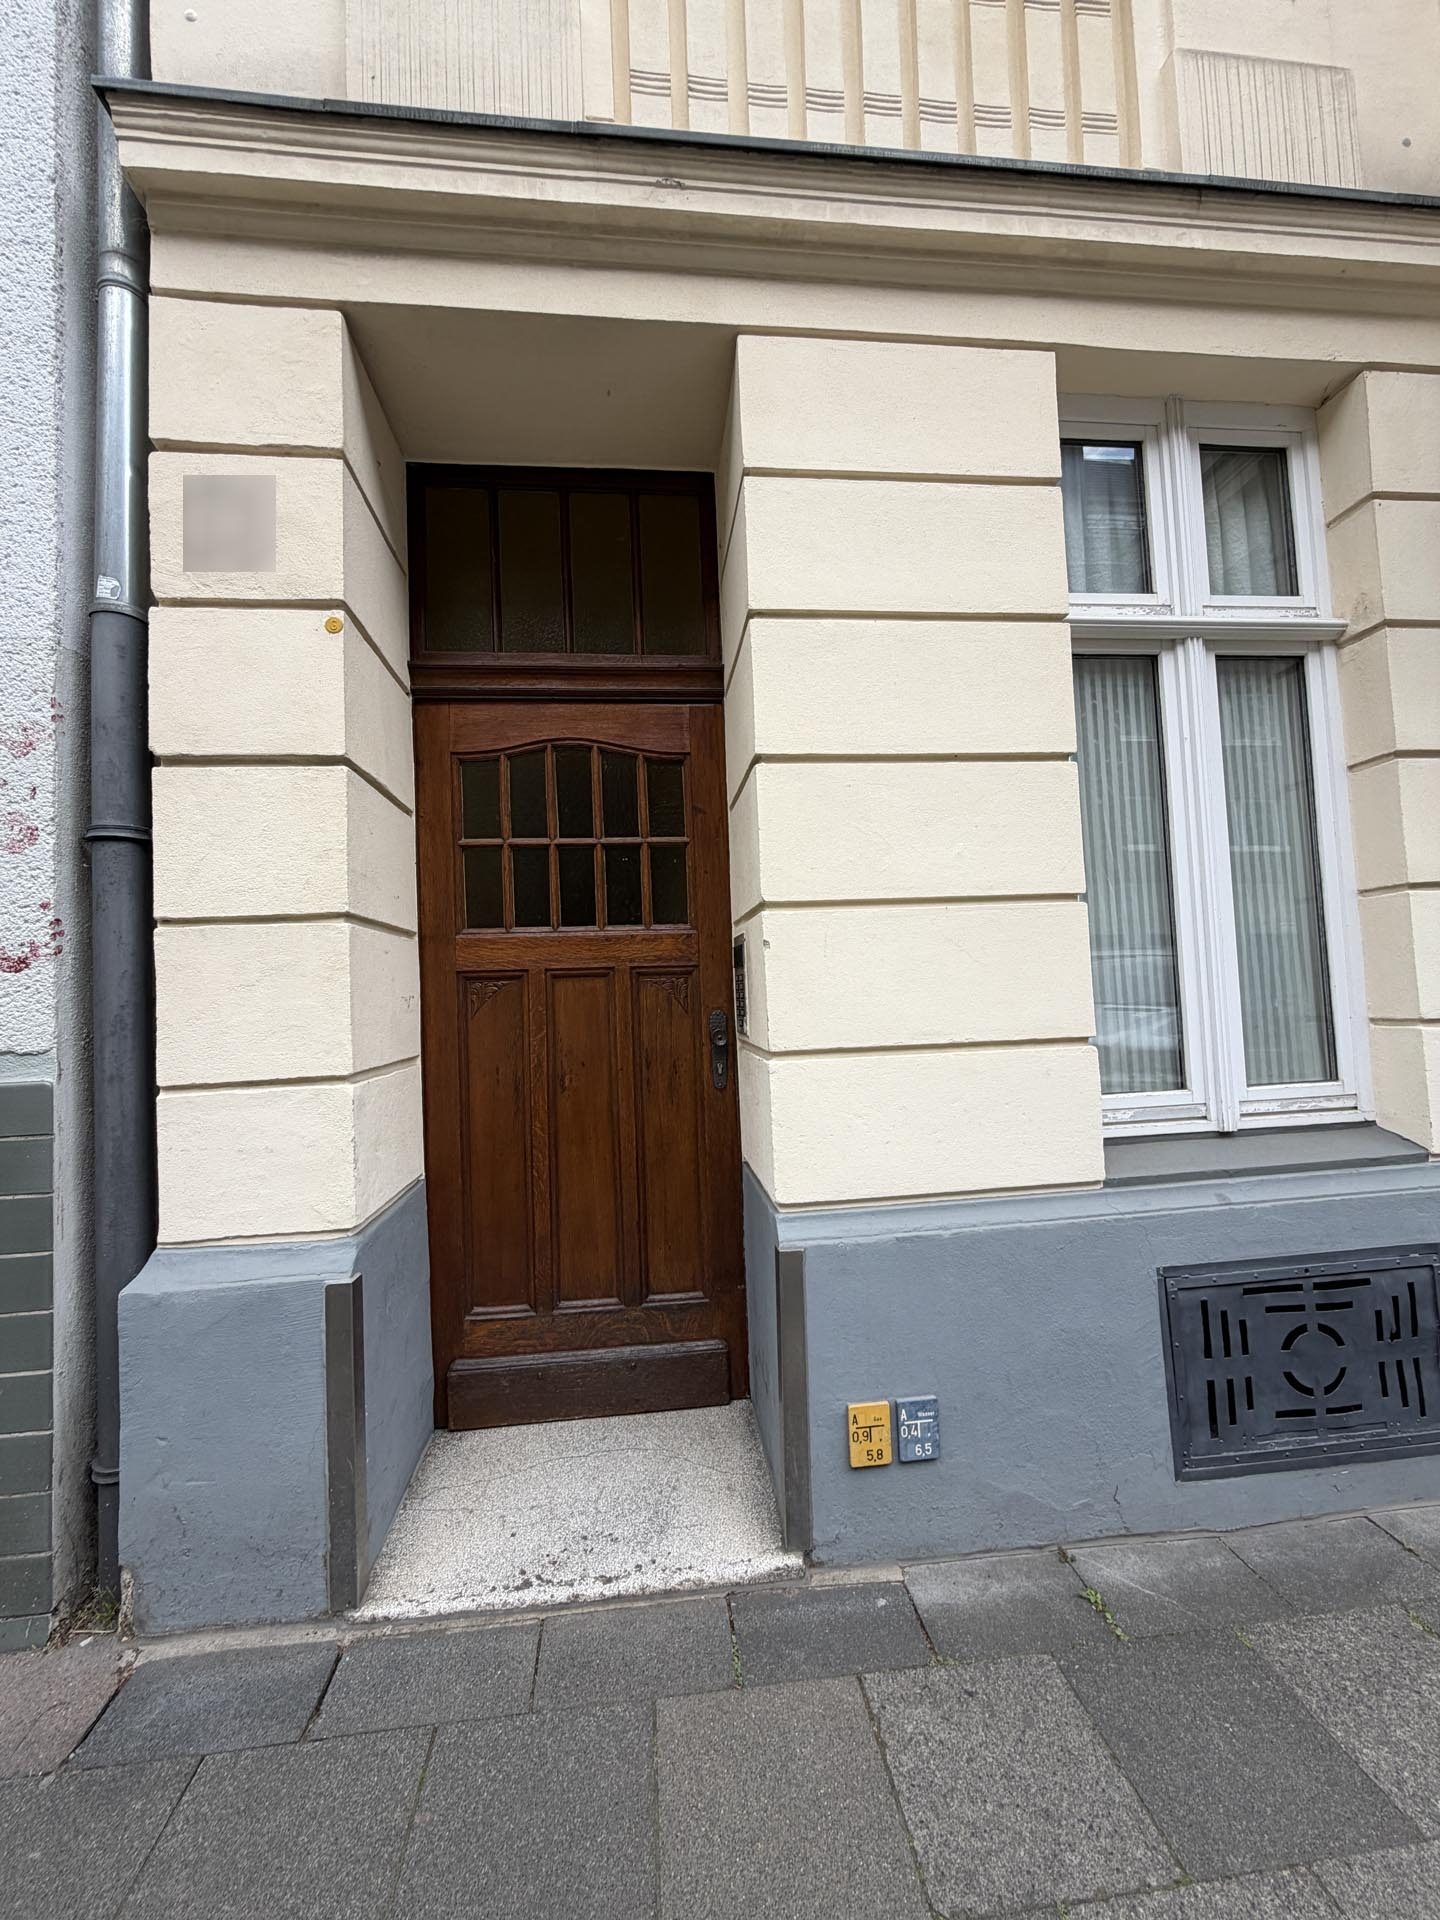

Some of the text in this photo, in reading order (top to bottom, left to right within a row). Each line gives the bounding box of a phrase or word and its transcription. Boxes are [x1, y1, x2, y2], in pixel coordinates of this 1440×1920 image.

[852, 1413, 858, 1425] A
[900, 1408, 907, 1421] A
[852, 1430, 869, 1444] 0,9
[900, 1425, 918, 1439] 0,4
[866, 1449, 883, 1462] 5,8
[915, 1443, 932, 1456] 6,5
